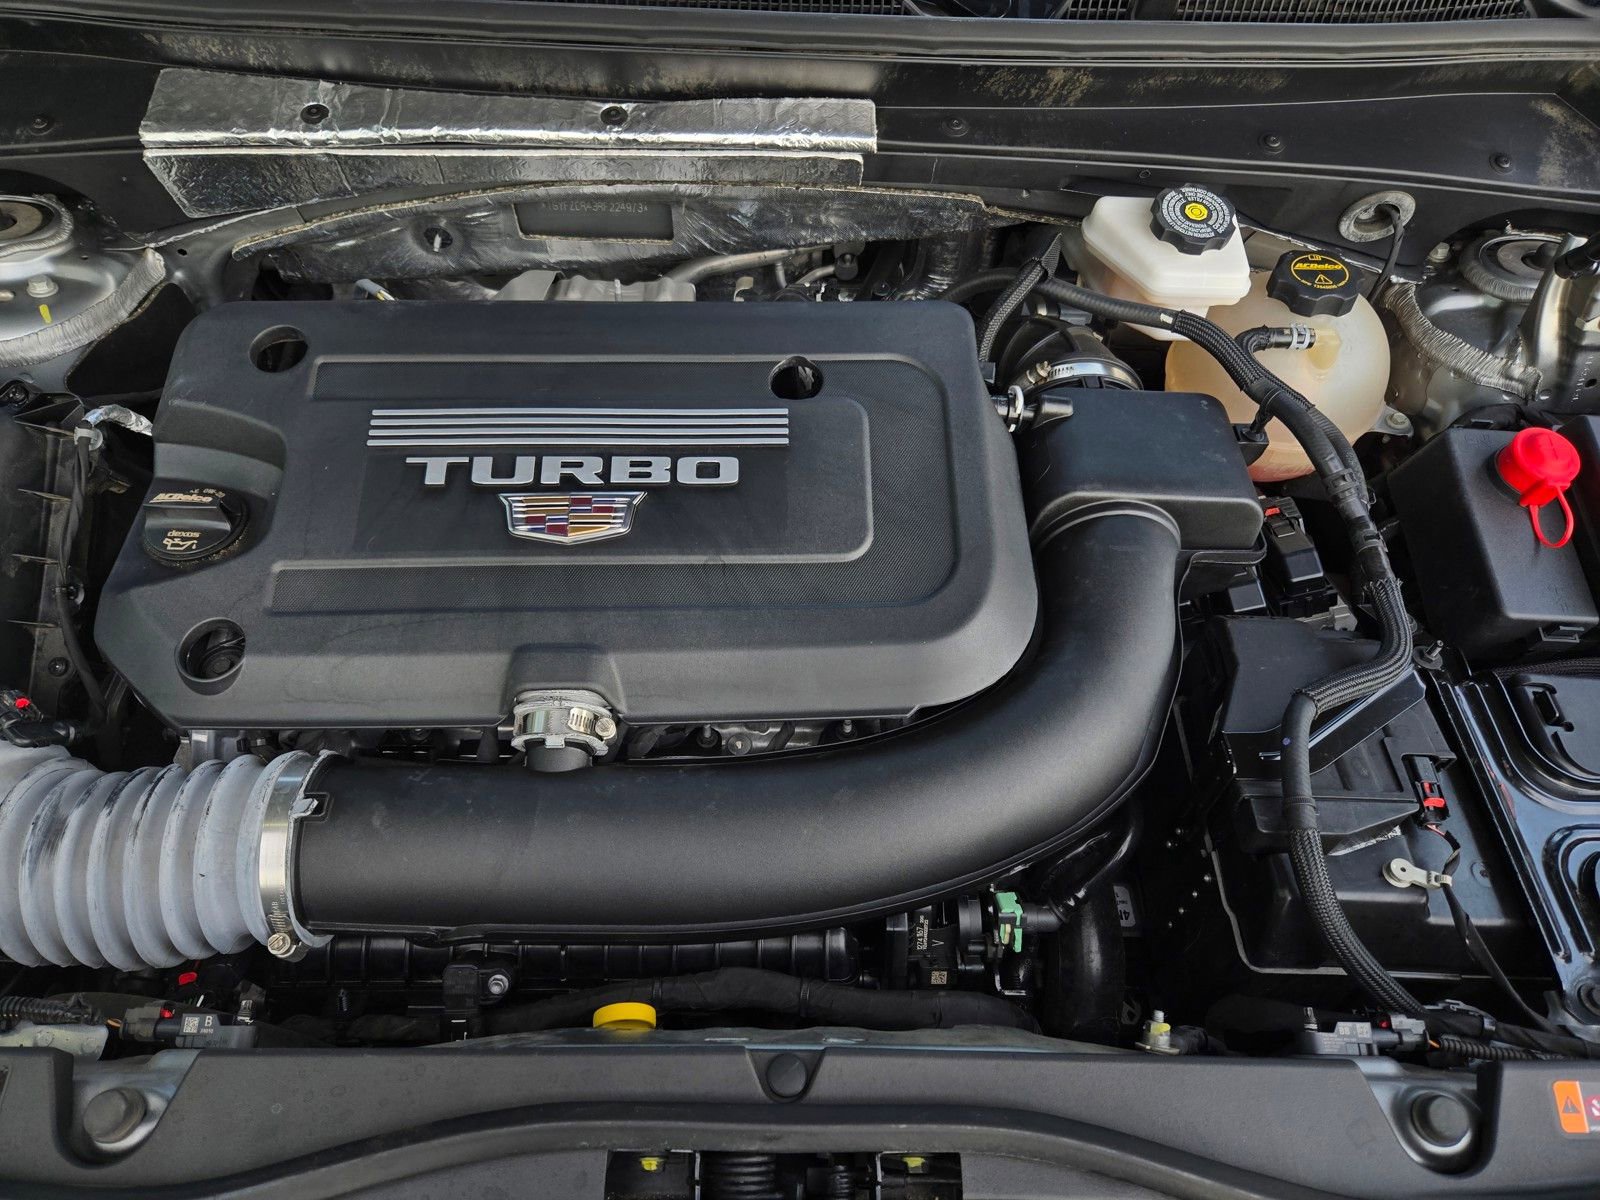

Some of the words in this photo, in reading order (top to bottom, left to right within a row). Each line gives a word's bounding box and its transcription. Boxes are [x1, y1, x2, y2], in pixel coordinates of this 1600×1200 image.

[1293, 262, 1343, 270] ACDelco
[405, 456, 739, 485] TURBO
[149, 493, 213, 504] ACDelco
[167, 529, 201, 538] dexos
[204, 1015, 213, 1027] B
